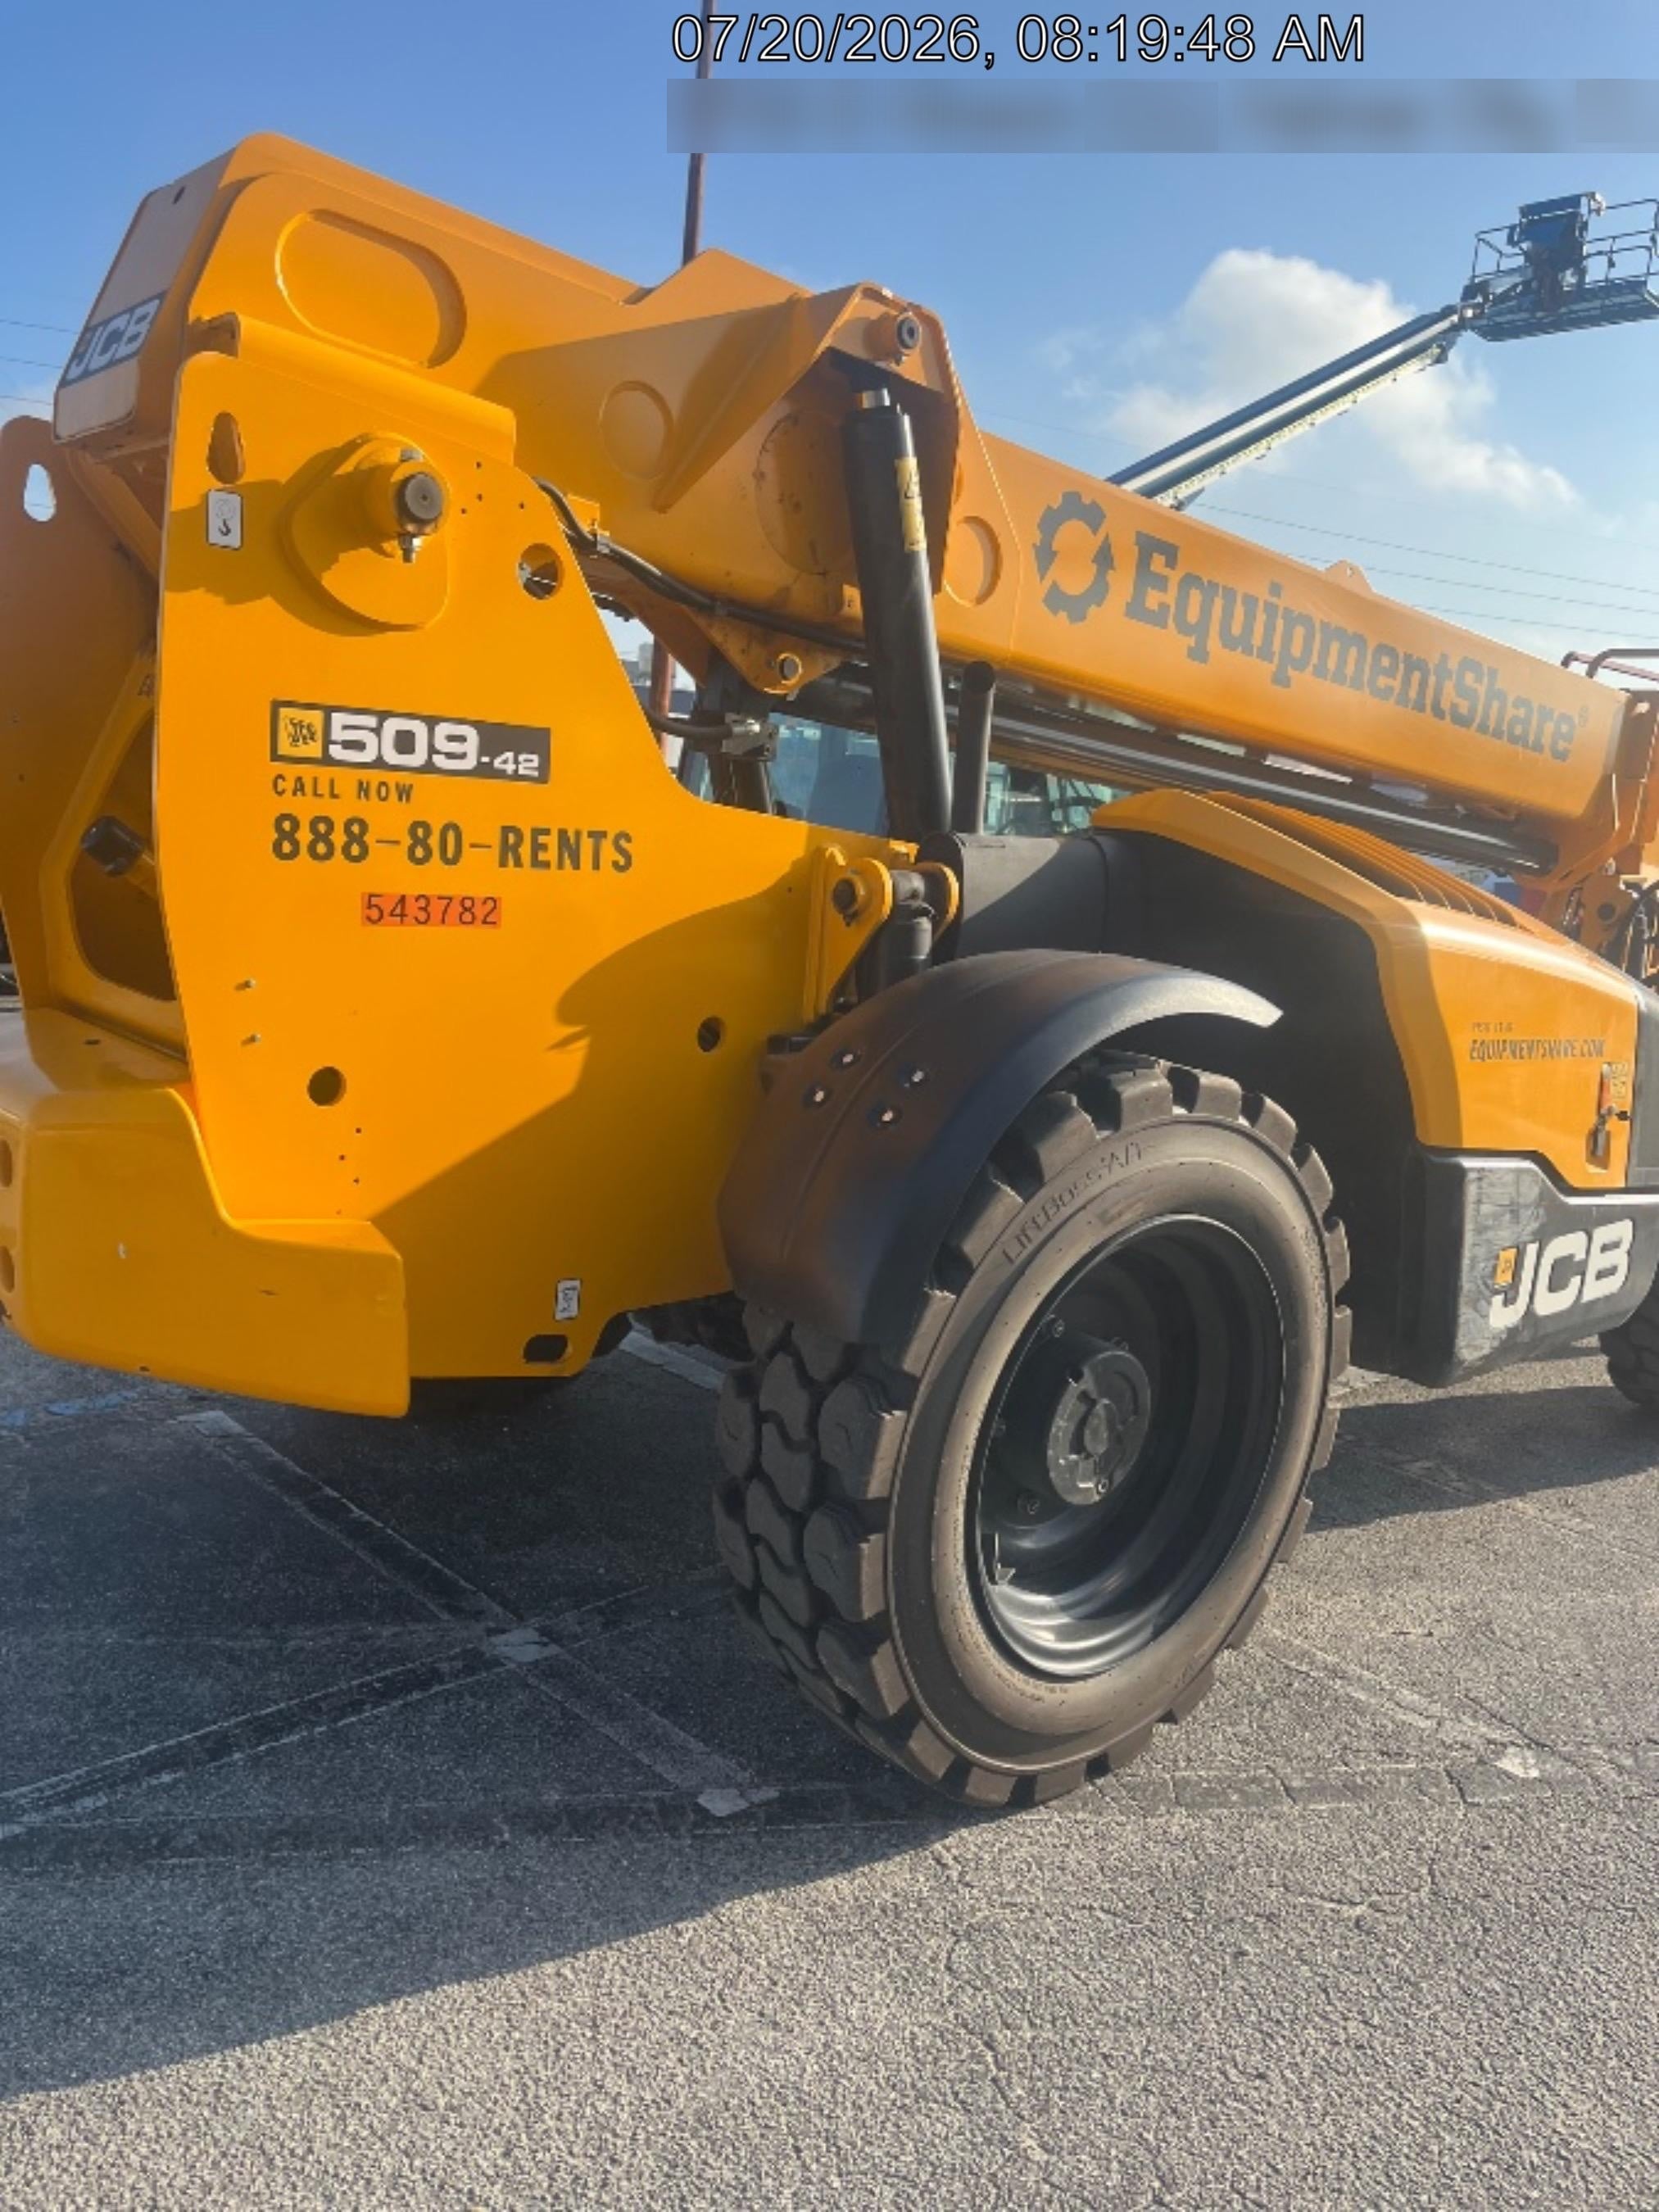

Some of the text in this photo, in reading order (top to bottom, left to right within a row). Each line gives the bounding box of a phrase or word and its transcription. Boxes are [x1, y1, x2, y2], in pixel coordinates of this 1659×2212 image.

[66, 297, 161, 382] JCB
[328, 712, 540, 777] 509-42
[272, 774, 414, 803] CALL NOW
[272, 813, 633, 873] 888-80-RENTS
[365, 894, 498, 926] 543782
[1489, 1218, 1634, 1330] JCB
